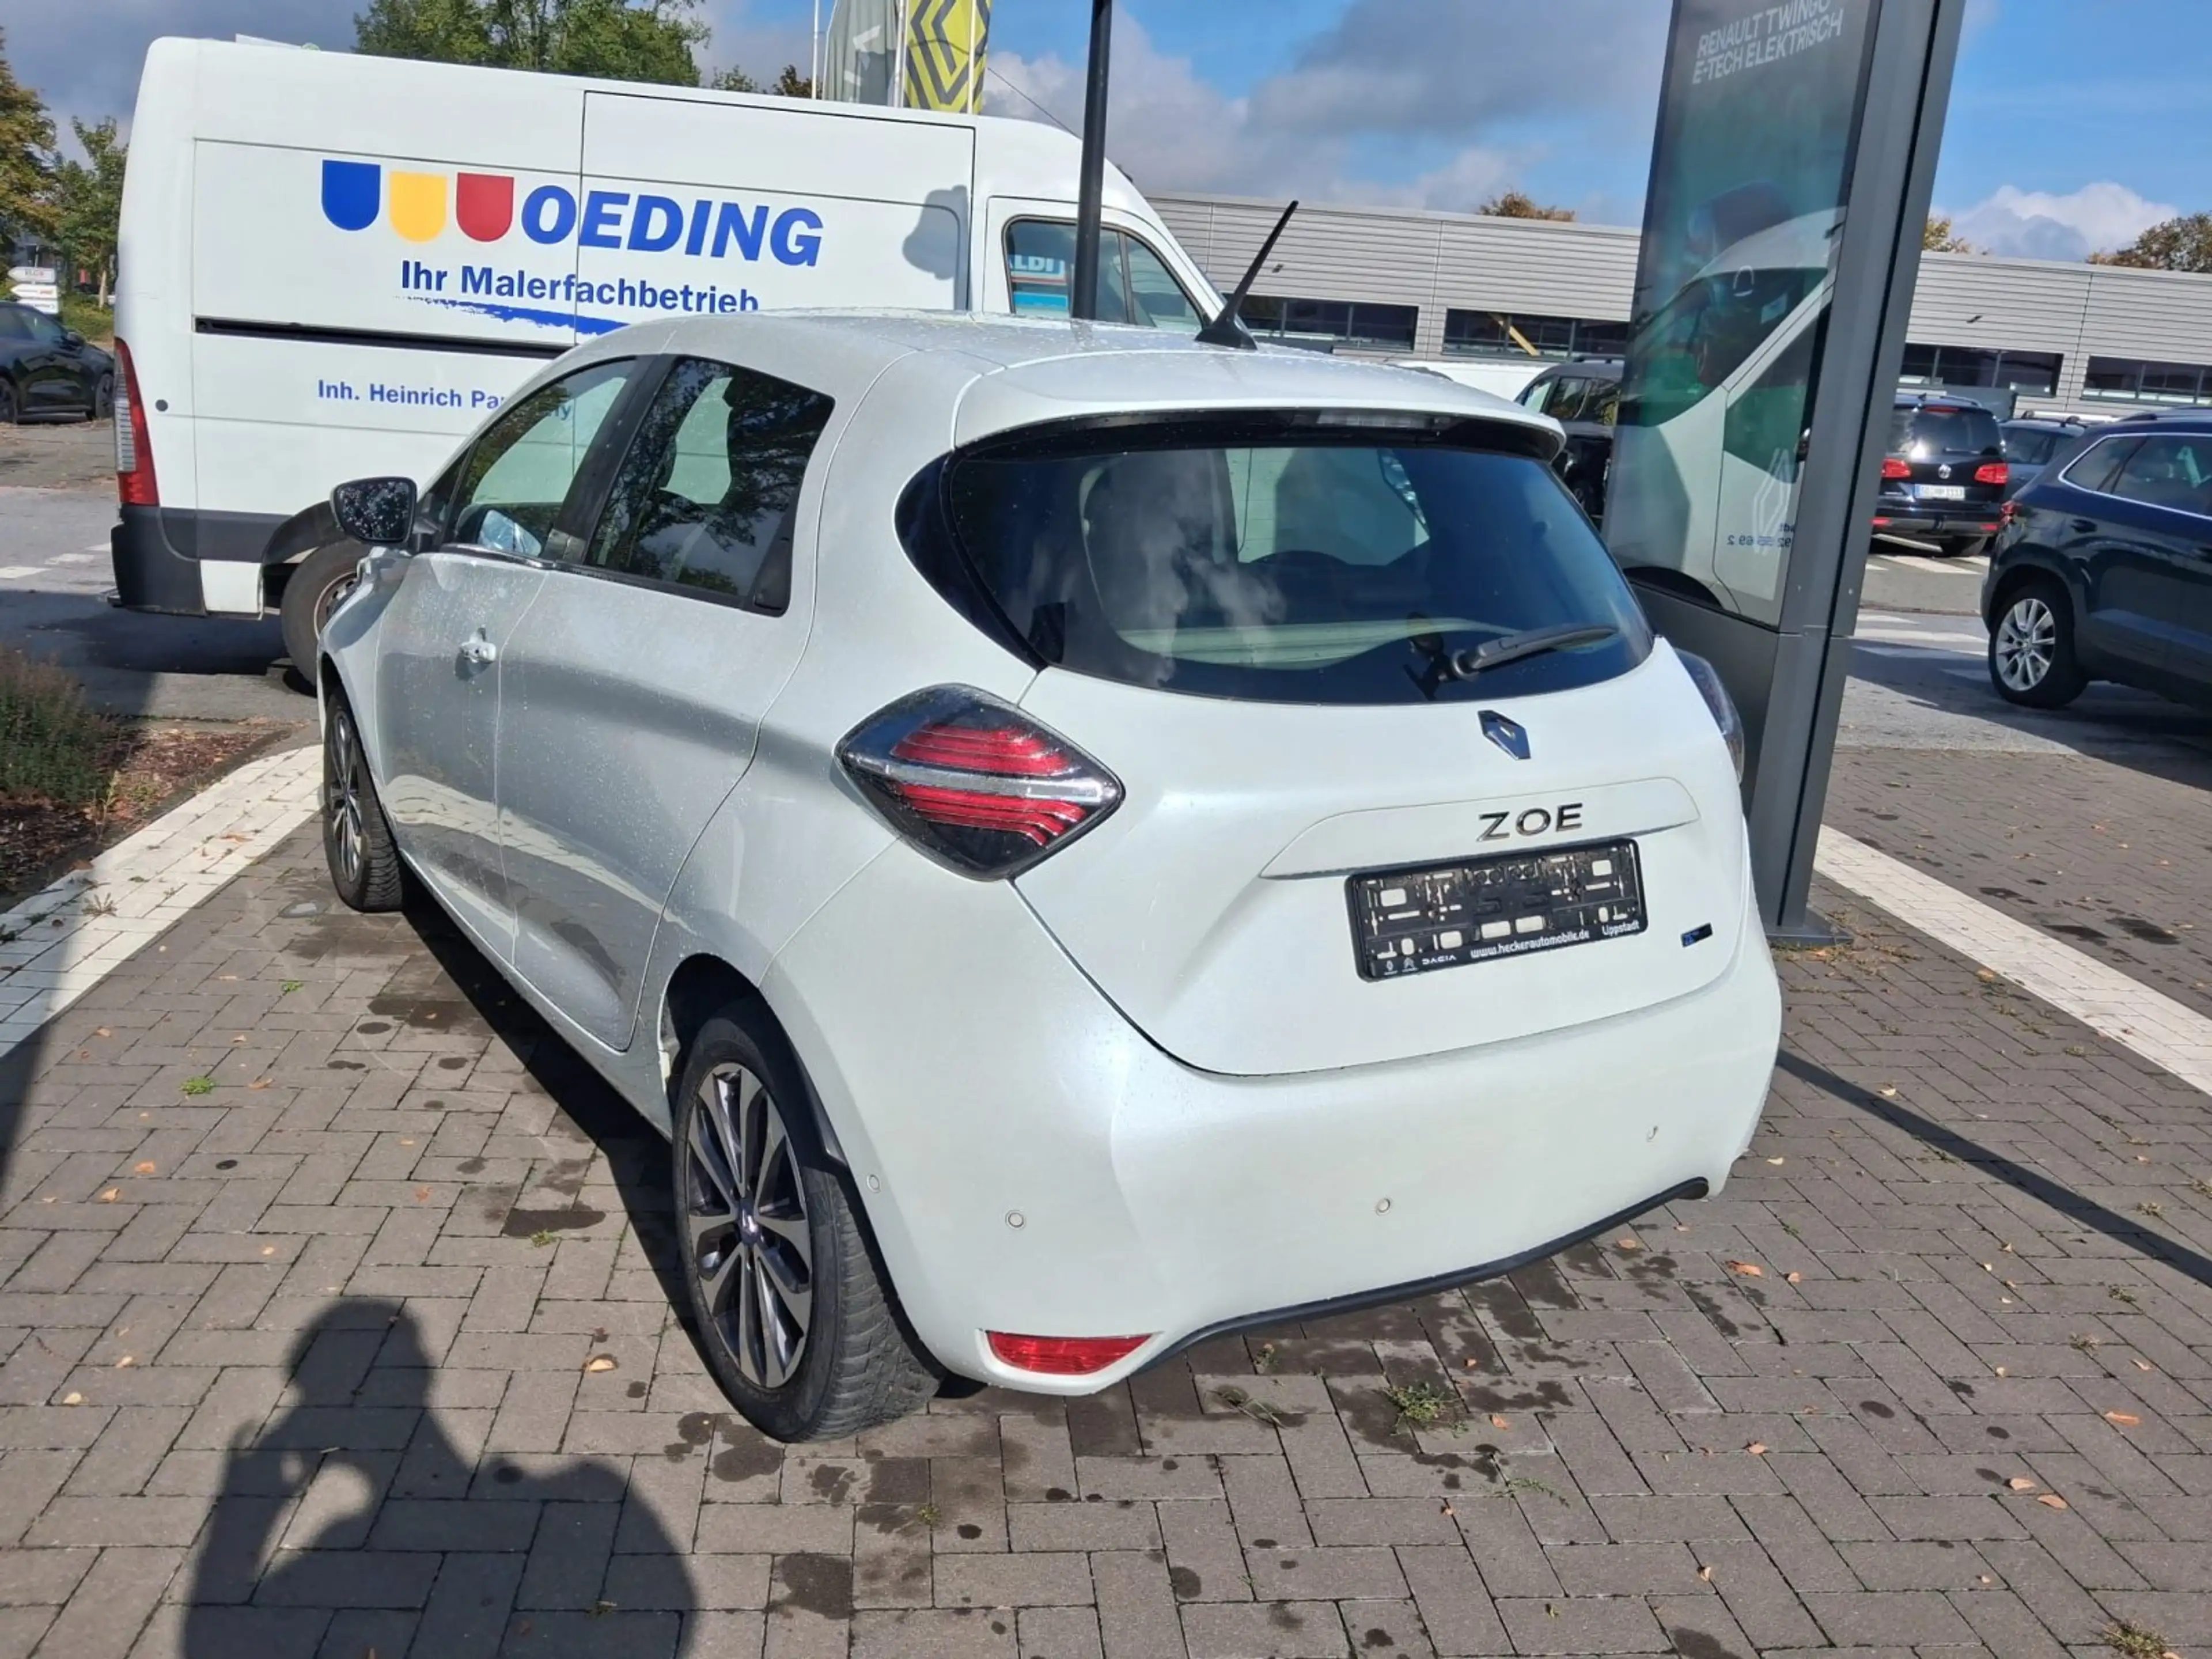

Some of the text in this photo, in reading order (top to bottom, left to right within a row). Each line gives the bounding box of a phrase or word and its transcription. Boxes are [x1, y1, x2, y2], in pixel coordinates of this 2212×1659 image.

[1692, 7, 1844, 84] E-TECH ELEKTRISCH
[1696, 12, 1763, 58] RENAULT
[522, 185, 822, 266] OEDING
[402, 261, 759, 314] Ihr Malerfachbetrieb
[319, 380, 360, 400] Inh.
[369, 384, 463, 408] Heinrich
[1476, 802, 1583, 842] ZOE
[1470, 929, 1590, 959] www.heckerautomobile.de
